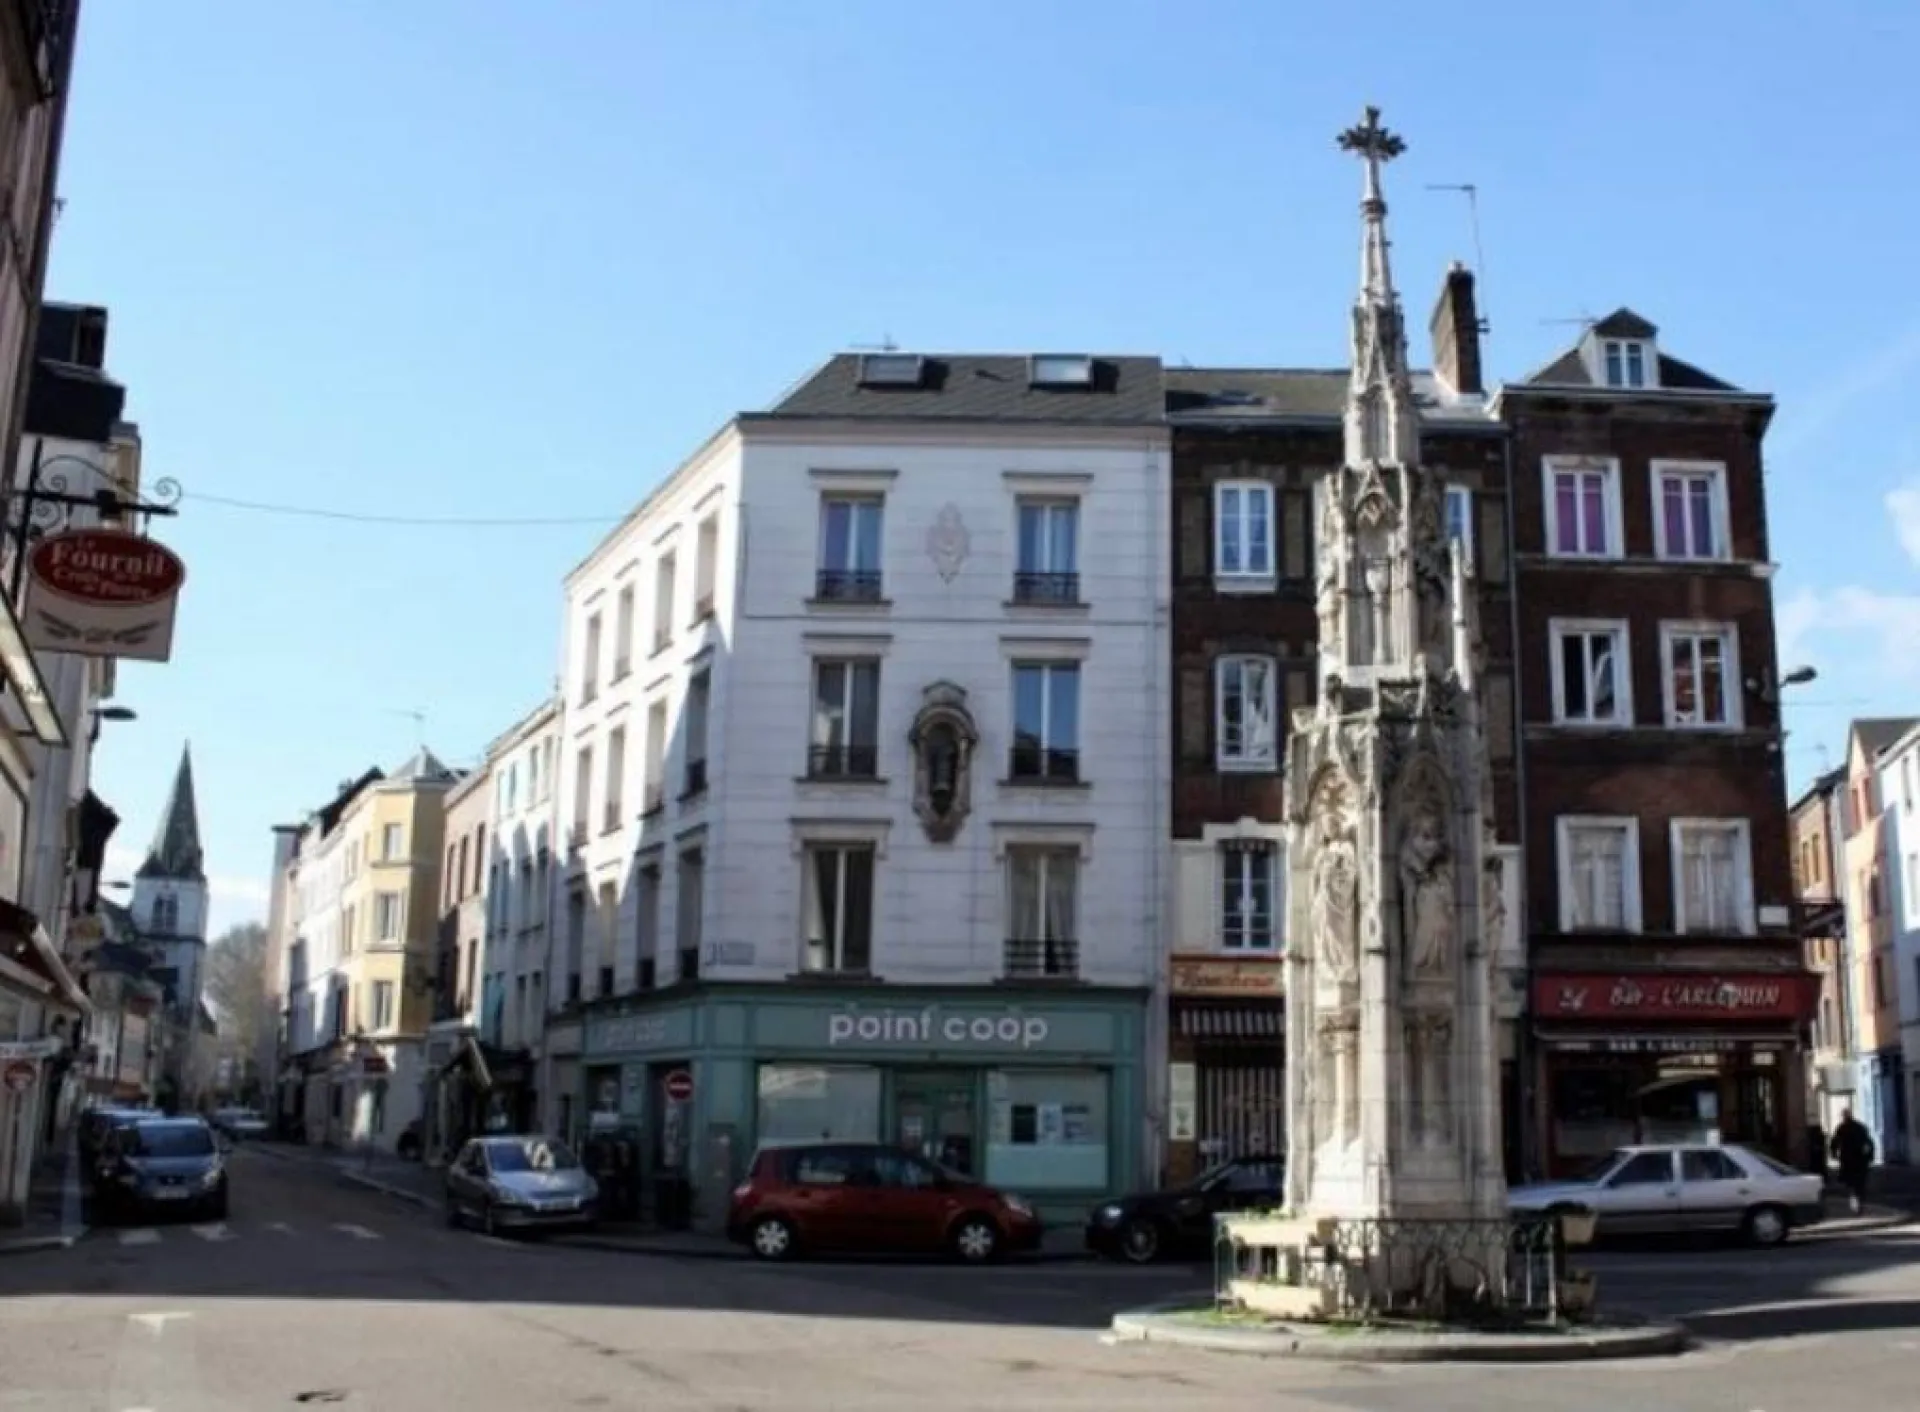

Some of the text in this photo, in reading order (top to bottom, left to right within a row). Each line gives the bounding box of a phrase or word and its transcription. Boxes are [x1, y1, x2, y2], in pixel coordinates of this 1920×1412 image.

[50, 541, 165, 576] Fournil
[829, 1008, 1049, 1048] point coop
